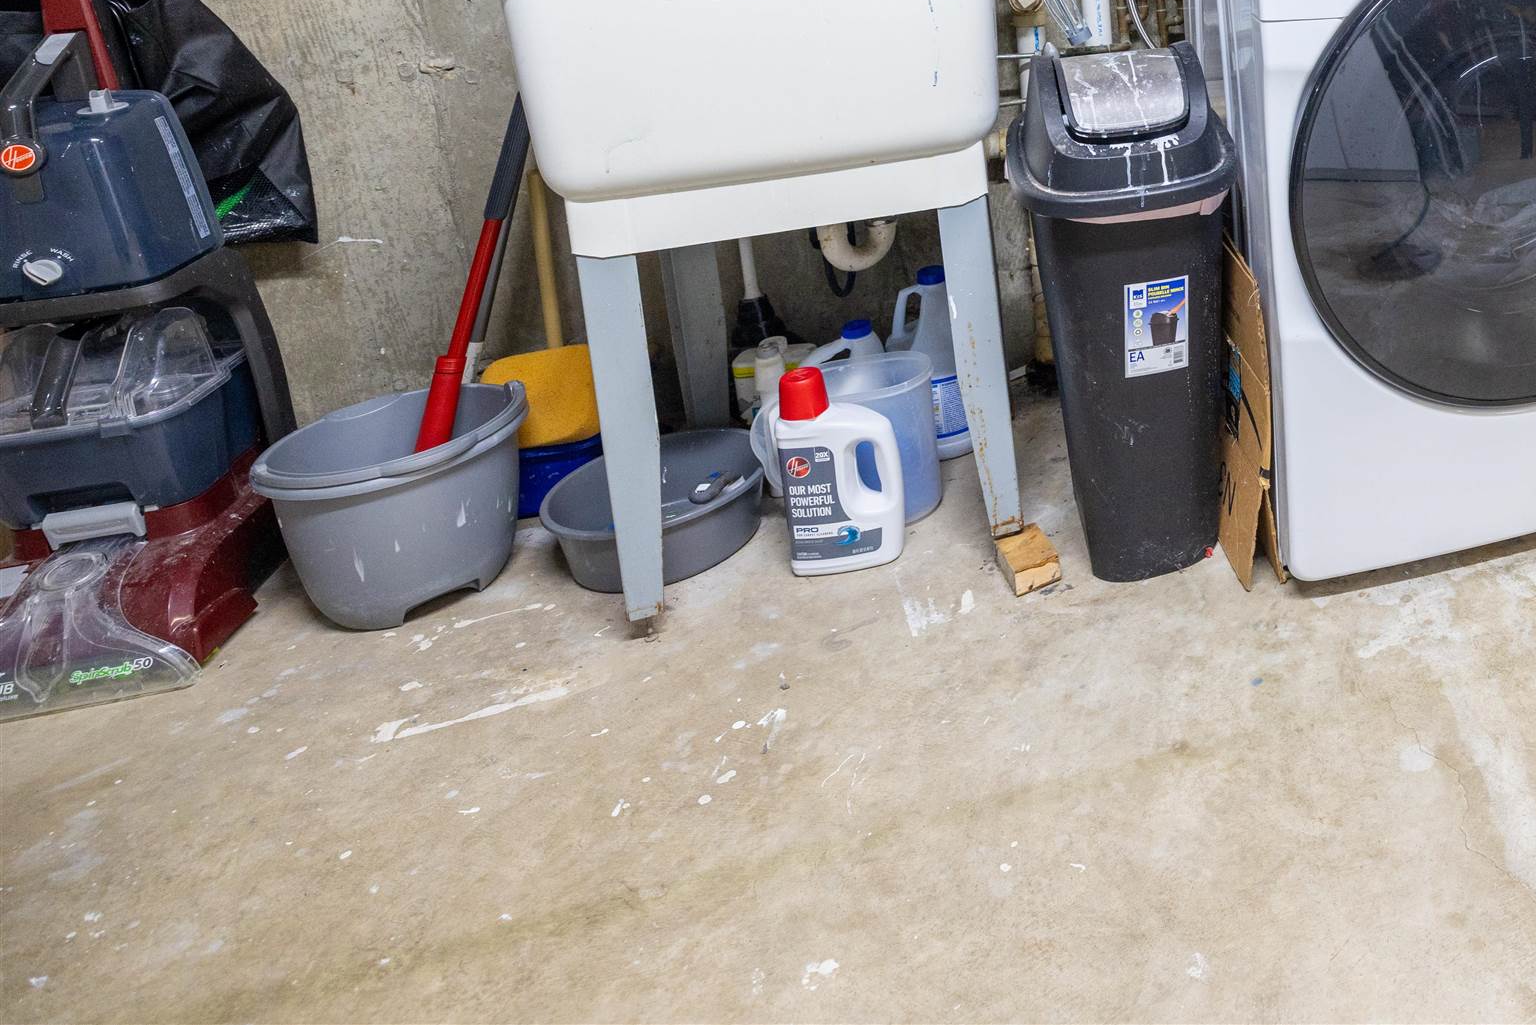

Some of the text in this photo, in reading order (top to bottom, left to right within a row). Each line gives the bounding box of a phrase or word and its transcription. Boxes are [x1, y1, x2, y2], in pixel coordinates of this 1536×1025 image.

[12, 248, 33, 269] RINSE
[50, 247, 75, 262] WASH
[1129, 351, 1145, 363] EA
[789, 483, 832, 496] OUR MOST
[790, 494, 836, 507] POWERFUL
[791, 506, 832, 518] SOLUTION
